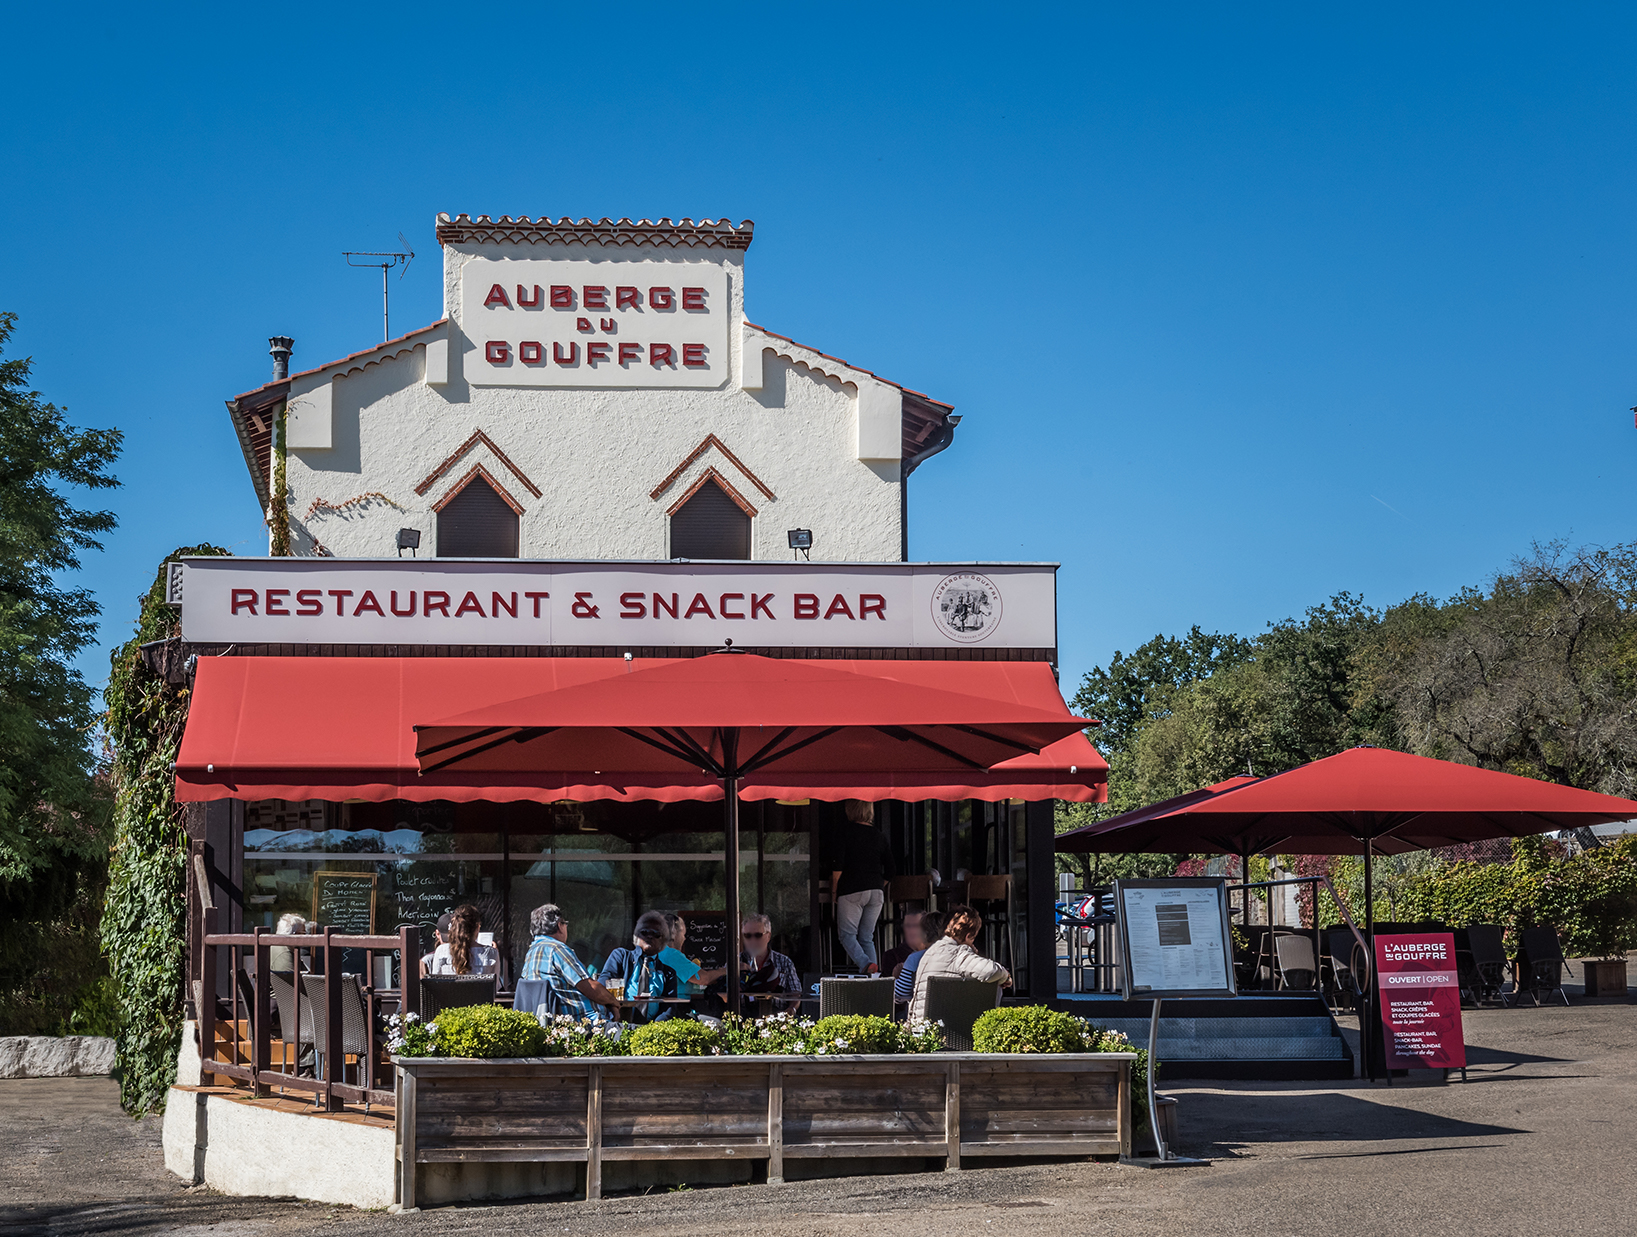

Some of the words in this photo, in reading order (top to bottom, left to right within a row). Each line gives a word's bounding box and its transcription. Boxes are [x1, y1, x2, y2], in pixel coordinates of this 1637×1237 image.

[483, 283, 705, 310] AUBERGE
[576, 317, 613, 331] DU
[485, 340, 705, 366] GOUFFRE
[231, 588, 550, 619] RESTAURANT
[571, 592, 601, 619] &
[619, 592, 776, 620] SNACK
[794, 593, 886, 620] BAR
[1384, 943, 1447, 952] L'AUBERGE
[1394, 952, 1447, 961] GOUFFRE
[1388, 976, 1421, 984] OUVERT
[1426, 975, 1449, 983] OPEN
